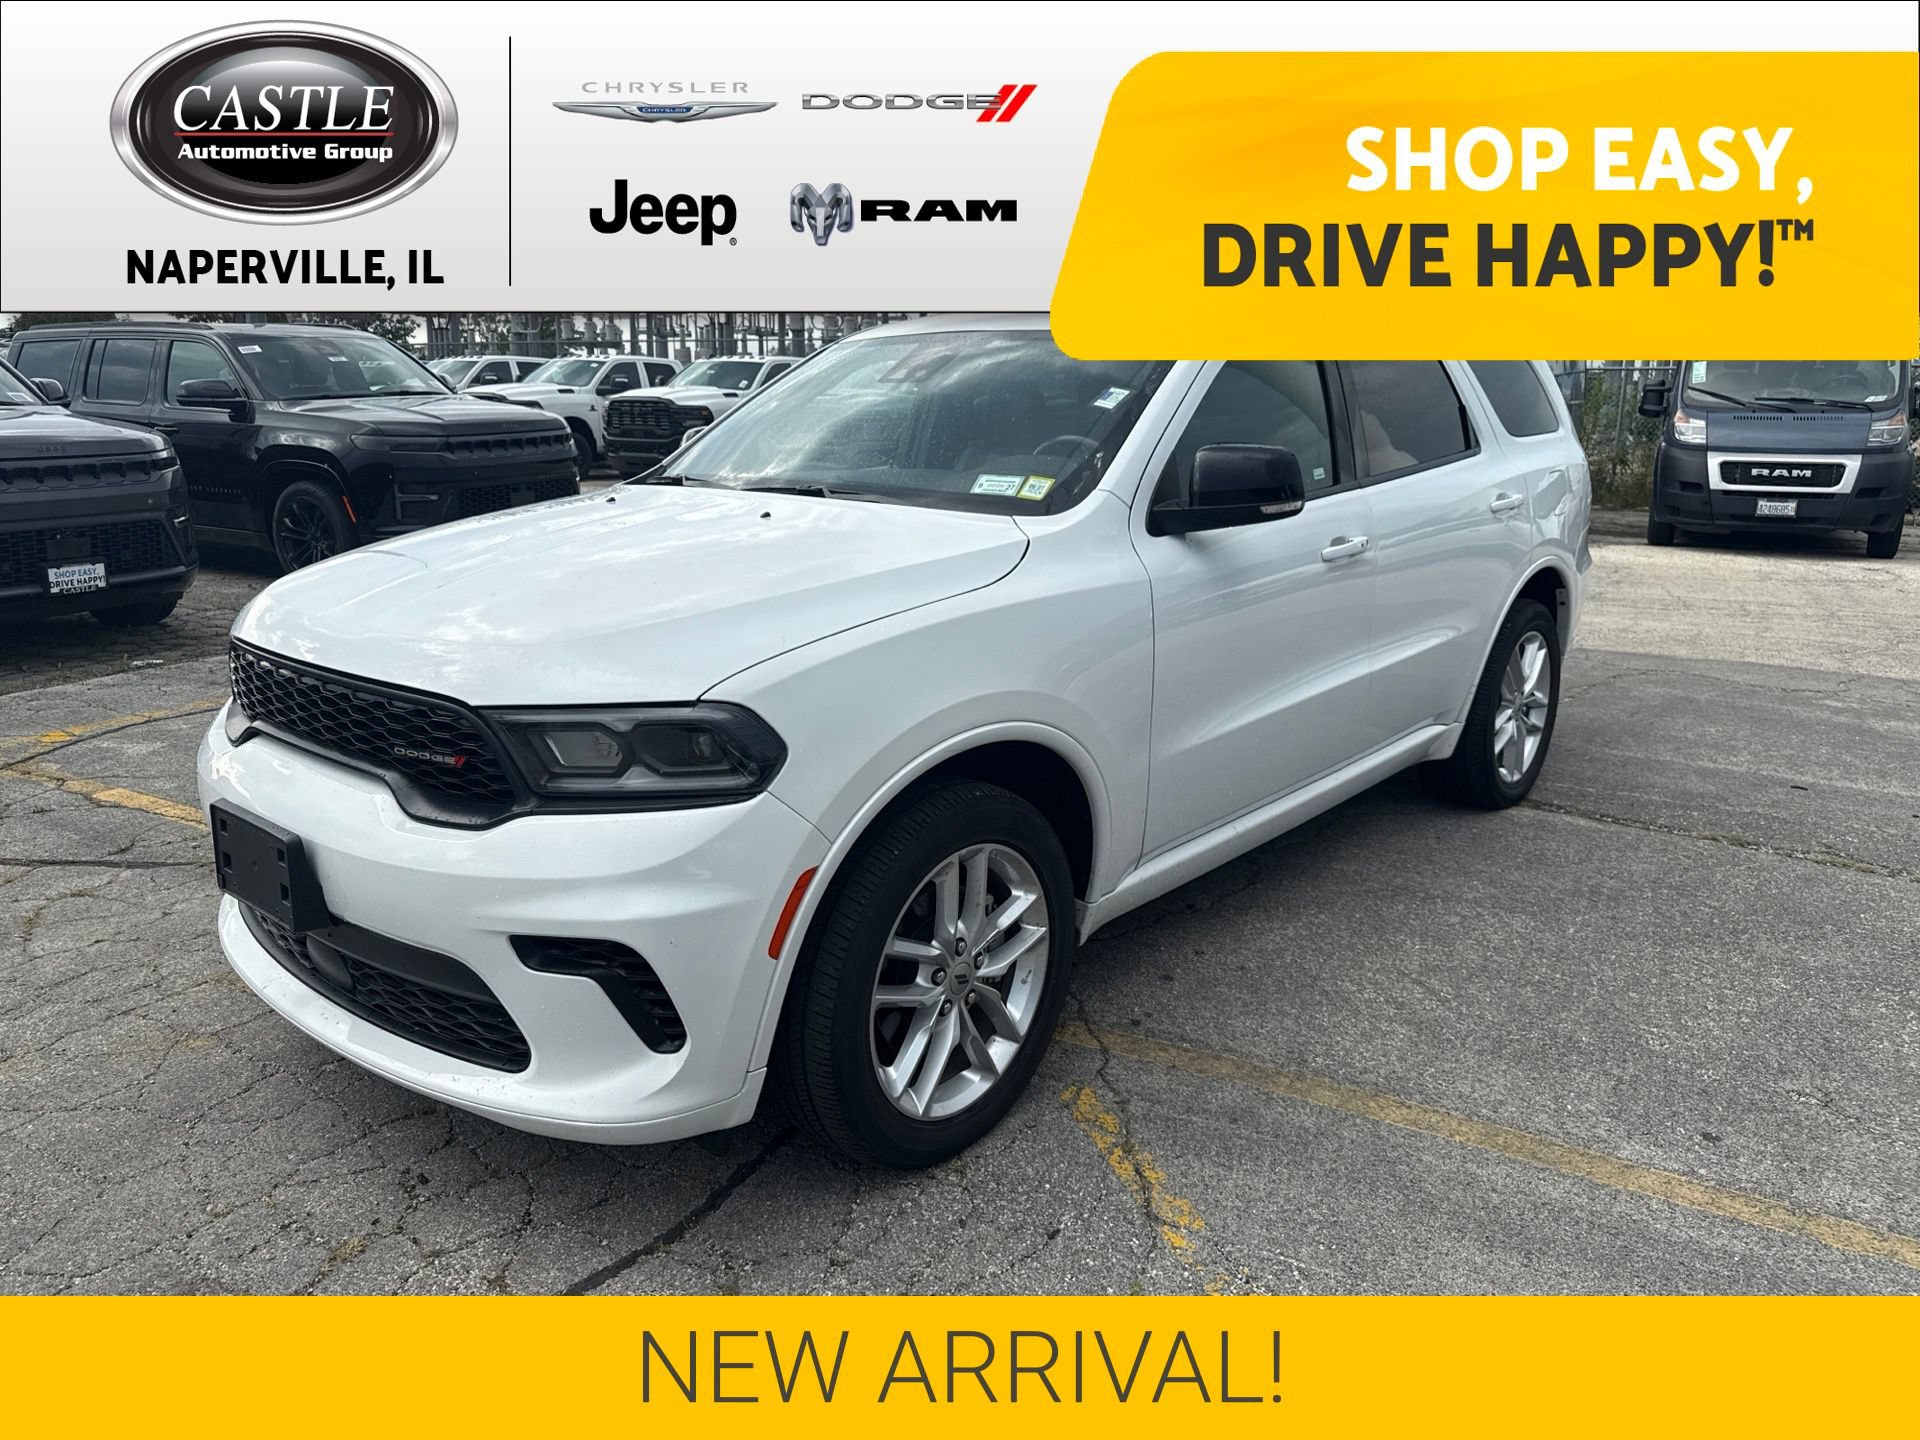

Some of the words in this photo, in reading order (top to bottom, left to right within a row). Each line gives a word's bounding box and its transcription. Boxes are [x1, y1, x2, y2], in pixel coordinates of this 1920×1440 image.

[1751, 468, 1812, 477] RAM
[54, 569, 77, 580] SHOP
[49, 578, 76, 589] DRIVE
[394, 747, 457, 765] DODGE
